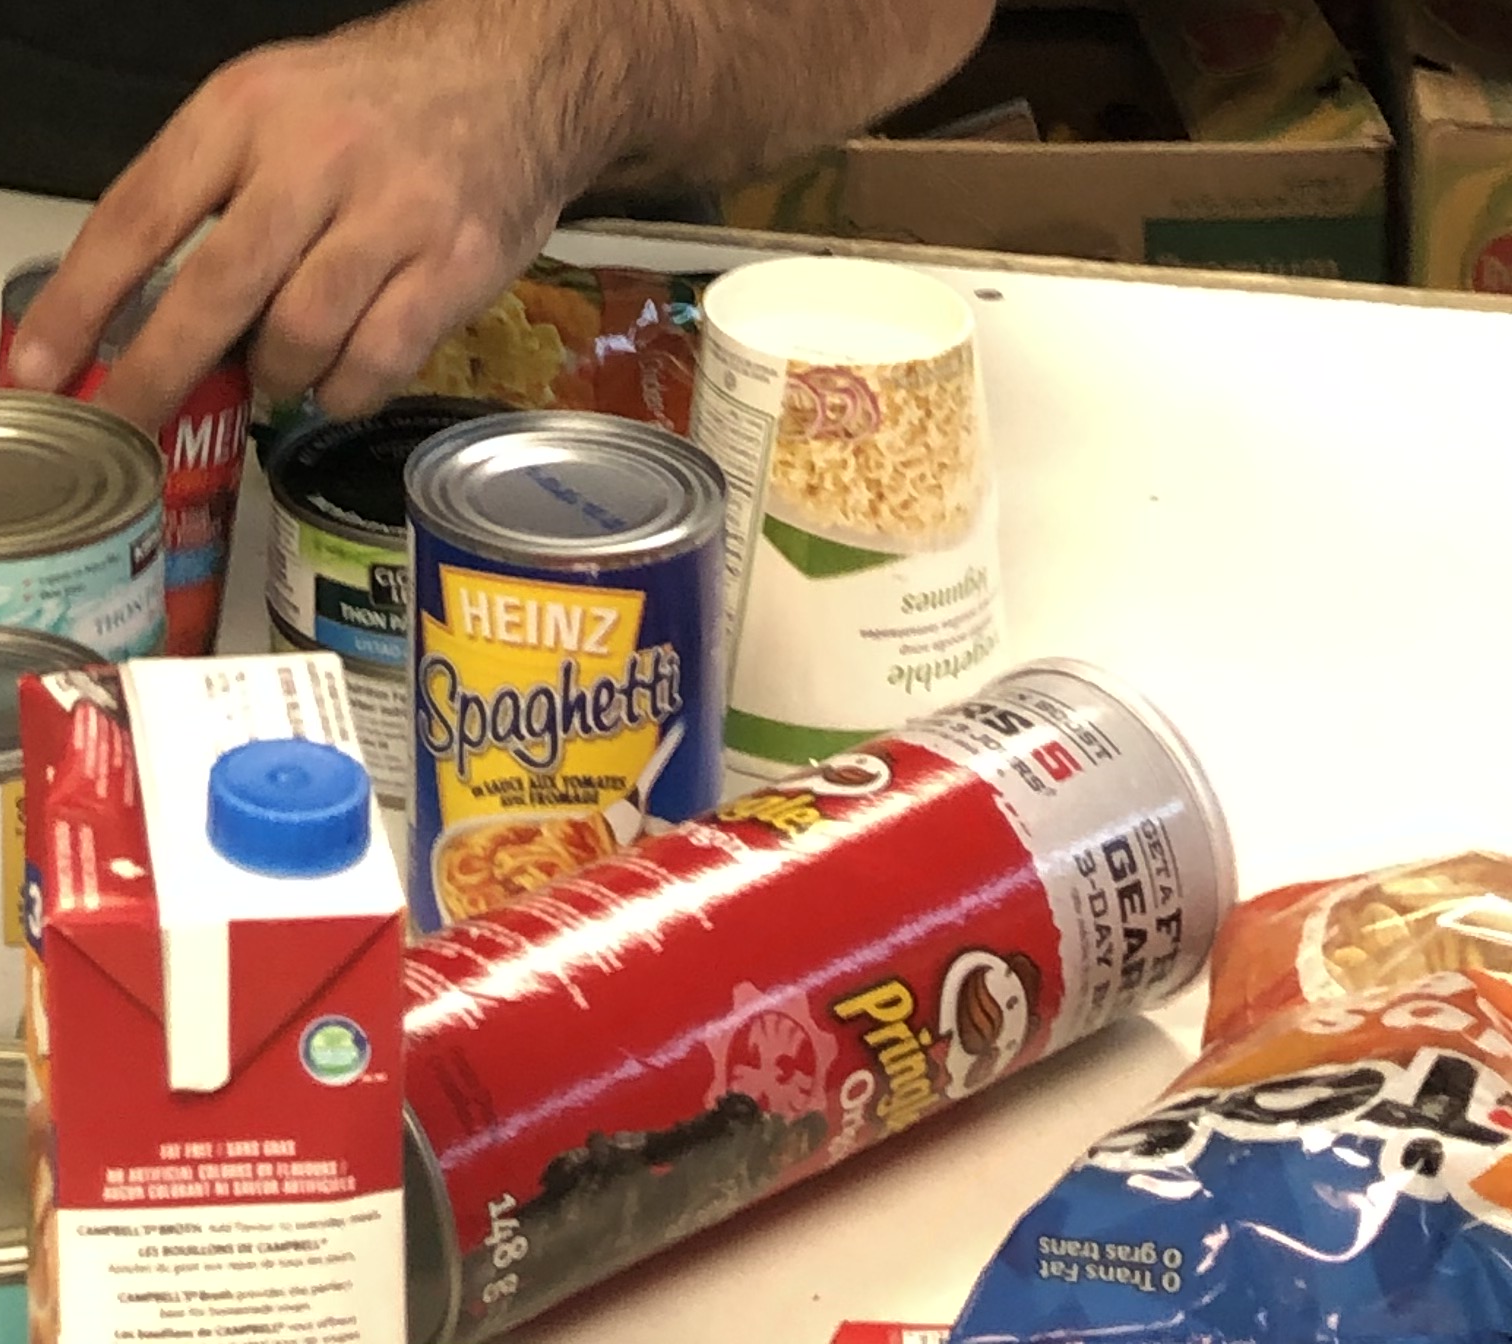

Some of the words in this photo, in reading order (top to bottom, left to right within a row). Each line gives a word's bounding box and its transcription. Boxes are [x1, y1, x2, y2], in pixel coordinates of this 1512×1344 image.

[459, 587, 620, 655] HEINZ
[418, 645, 683, 781] Spaghetti
[1031, 739, 1086, 782] 5
[1140, 817, 1171, 879] GET
[1159, 883, 1176, 905] A
[1073, 849, 1114, 968] 3-DAY
[484, 1192, 529, 1269] 148
[1039, 1236, 1101, 1262] trans
[1040, 1259, 1080, 1283] Fat
[1105, 1241, 1158, 1265] gras
[482, 1272, 519, 1304] g
[1085, 1263, 1157, 1293] Trans
